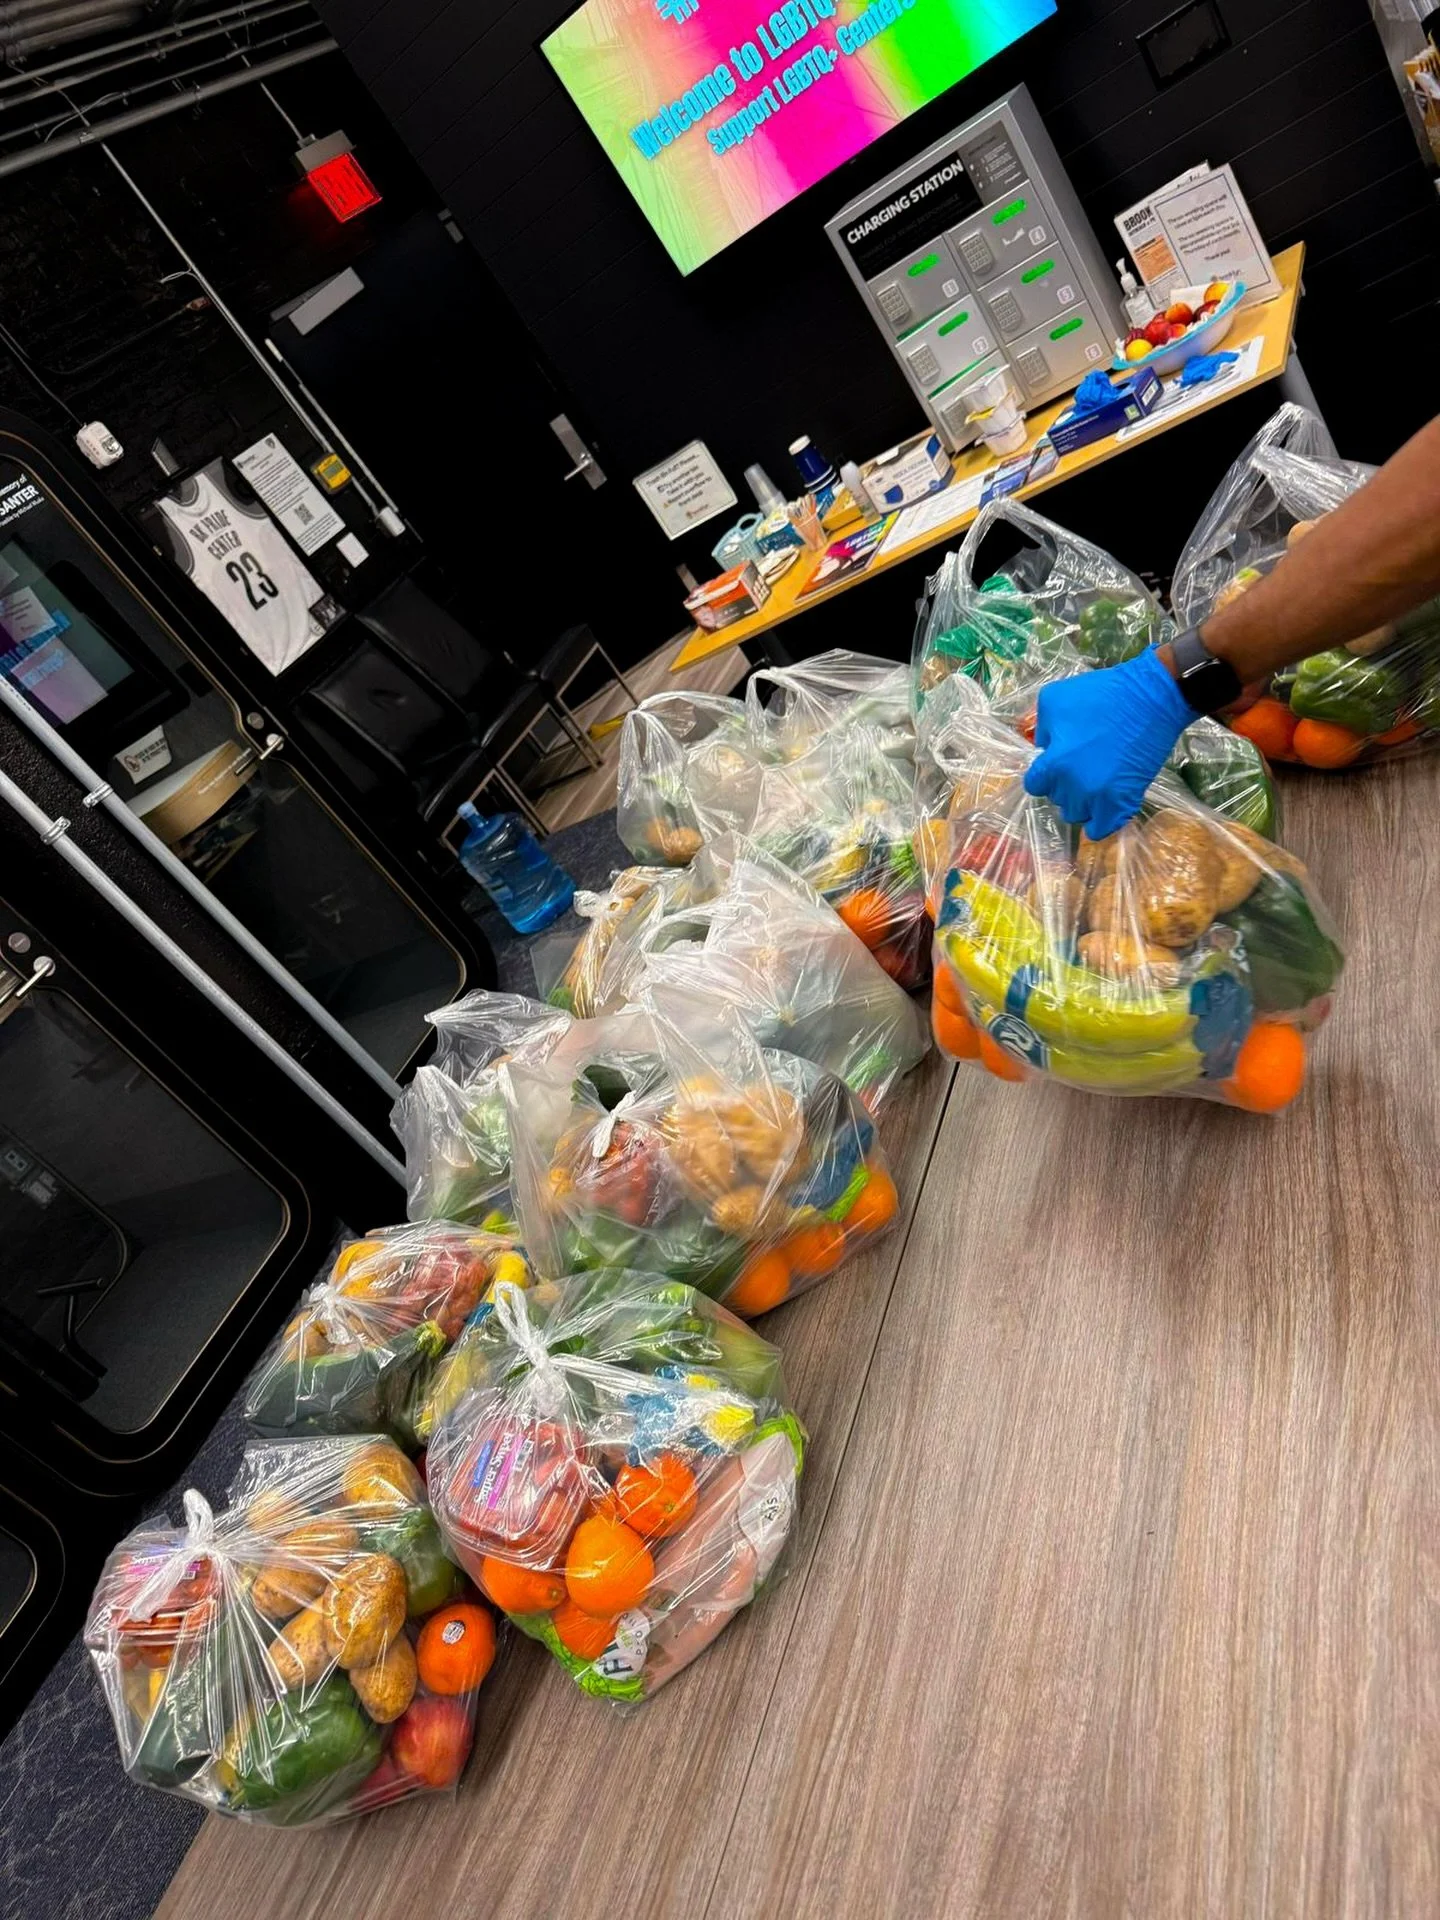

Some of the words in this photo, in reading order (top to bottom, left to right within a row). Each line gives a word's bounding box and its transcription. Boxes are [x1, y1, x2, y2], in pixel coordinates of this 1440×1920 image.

[629, 64, 737, 160] Welcome
[730, 42, 764, 81] to
[756, 0, 839, 60] LGBTQ
[707, 86, 780, 156] Support
[773, 45, 838, 104] LGBTQ+
[847, 196, 911, 244] CHARGING
[908, 159, 964, 204] STATION
[200, 509, 231, 534] PRIDE
[207, 530, 242, 560] CENTER
[226, 551, 279, 611] 23
